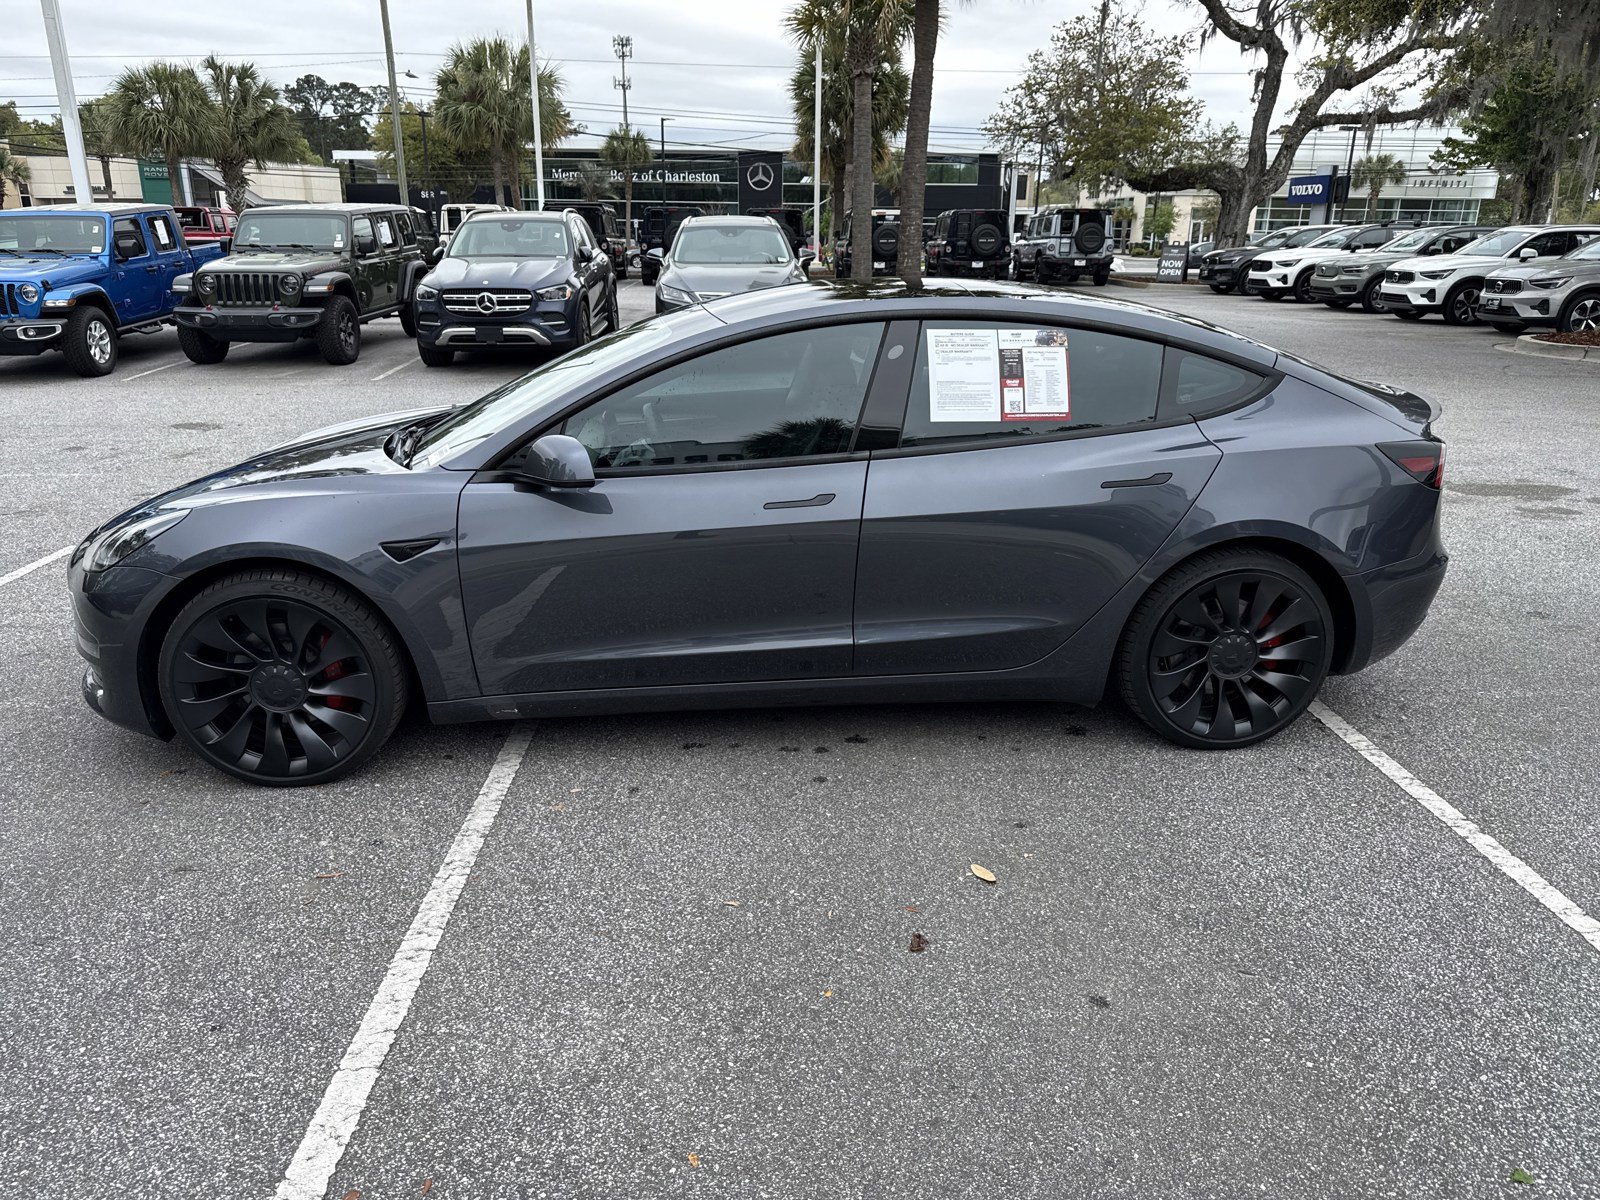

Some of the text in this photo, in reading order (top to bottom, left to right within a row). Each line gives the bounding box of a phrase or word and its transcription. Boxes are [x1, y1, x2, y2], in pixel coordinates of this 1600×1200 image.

[551, 168, 720, 182] MercBez of Charleston
[1412, 179, 1468, 188] INFINITI
[1291, 184, 1323, 196] VOLVO
[1161, 259, 1184, 268] NOW
[1159, 268, 1182, 276] OPEN
